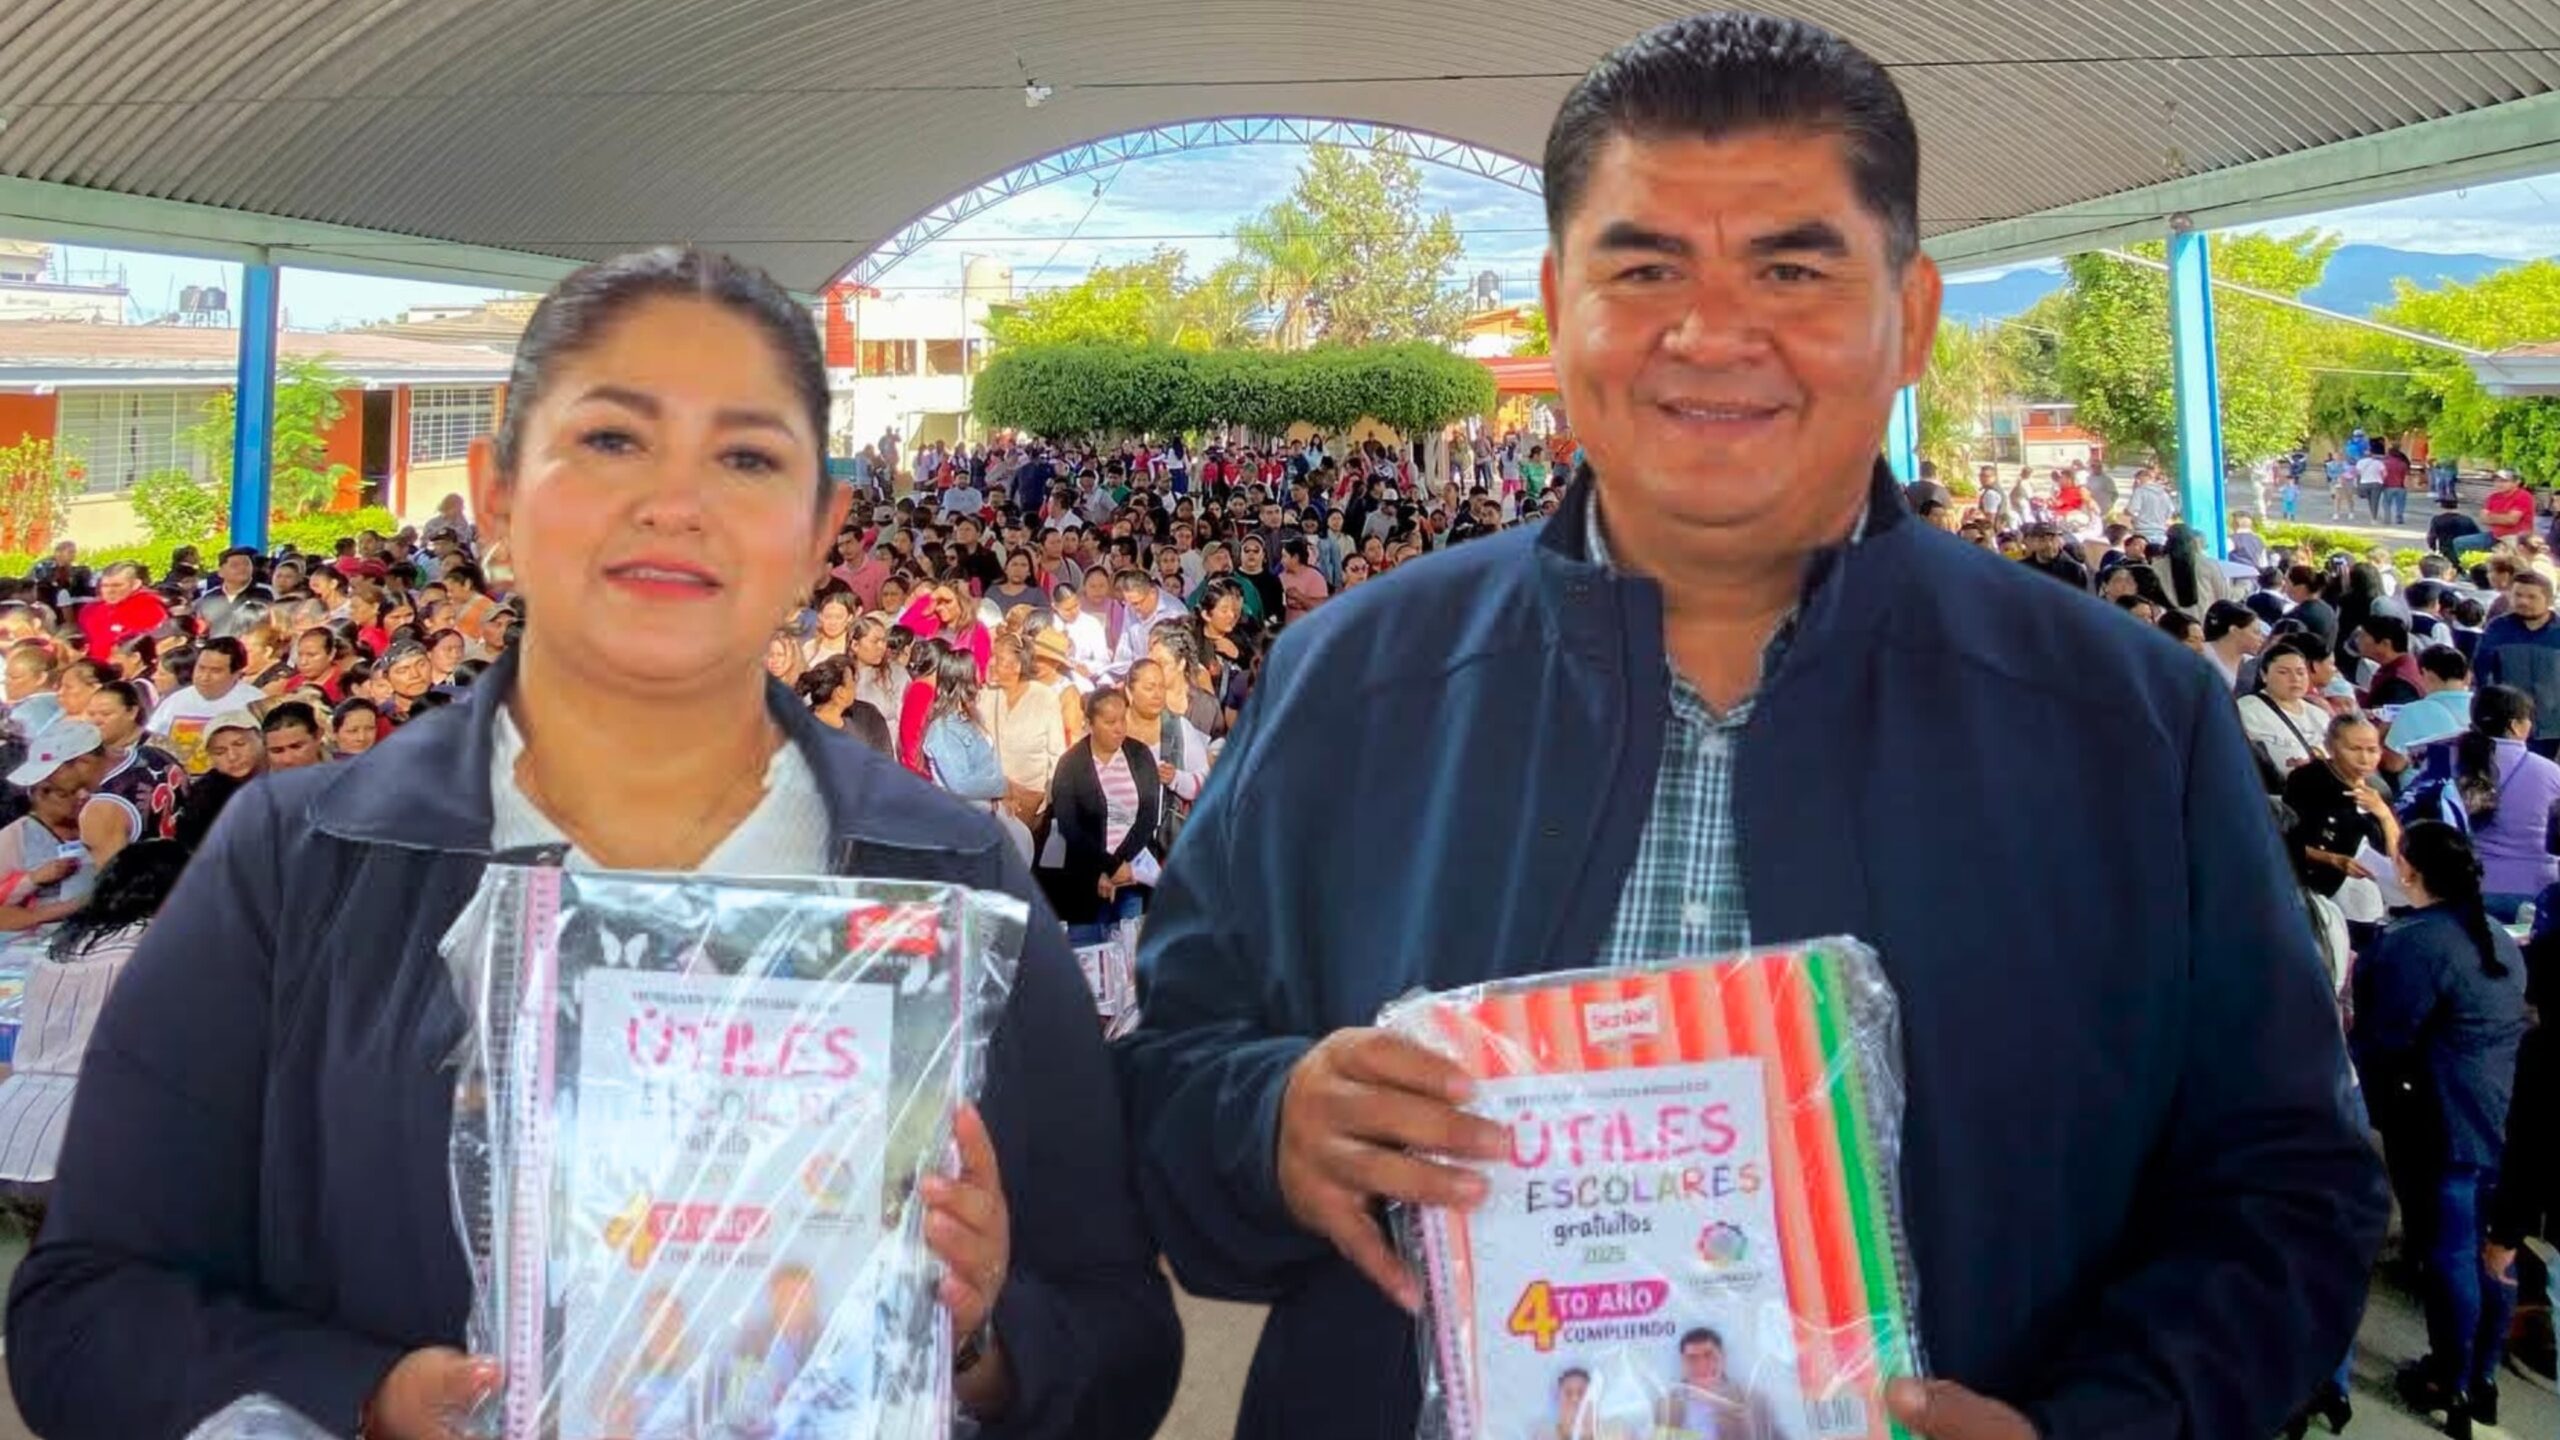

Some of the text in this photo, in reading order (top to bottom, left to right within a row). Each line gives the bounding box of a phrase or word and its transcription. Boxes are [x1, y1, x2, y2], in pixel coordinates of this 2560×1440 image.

[1507, 1103, 1738, 1168] ÚTILES
[1526, 1164, 1760, 1214] ESCOLARES
[1554, 1210, 1653, 1247] gratuitos
[1597, 1283, 1653, 1315] AÑO
[1562, 1319, 1677, 1343] CUMPLIENDO
